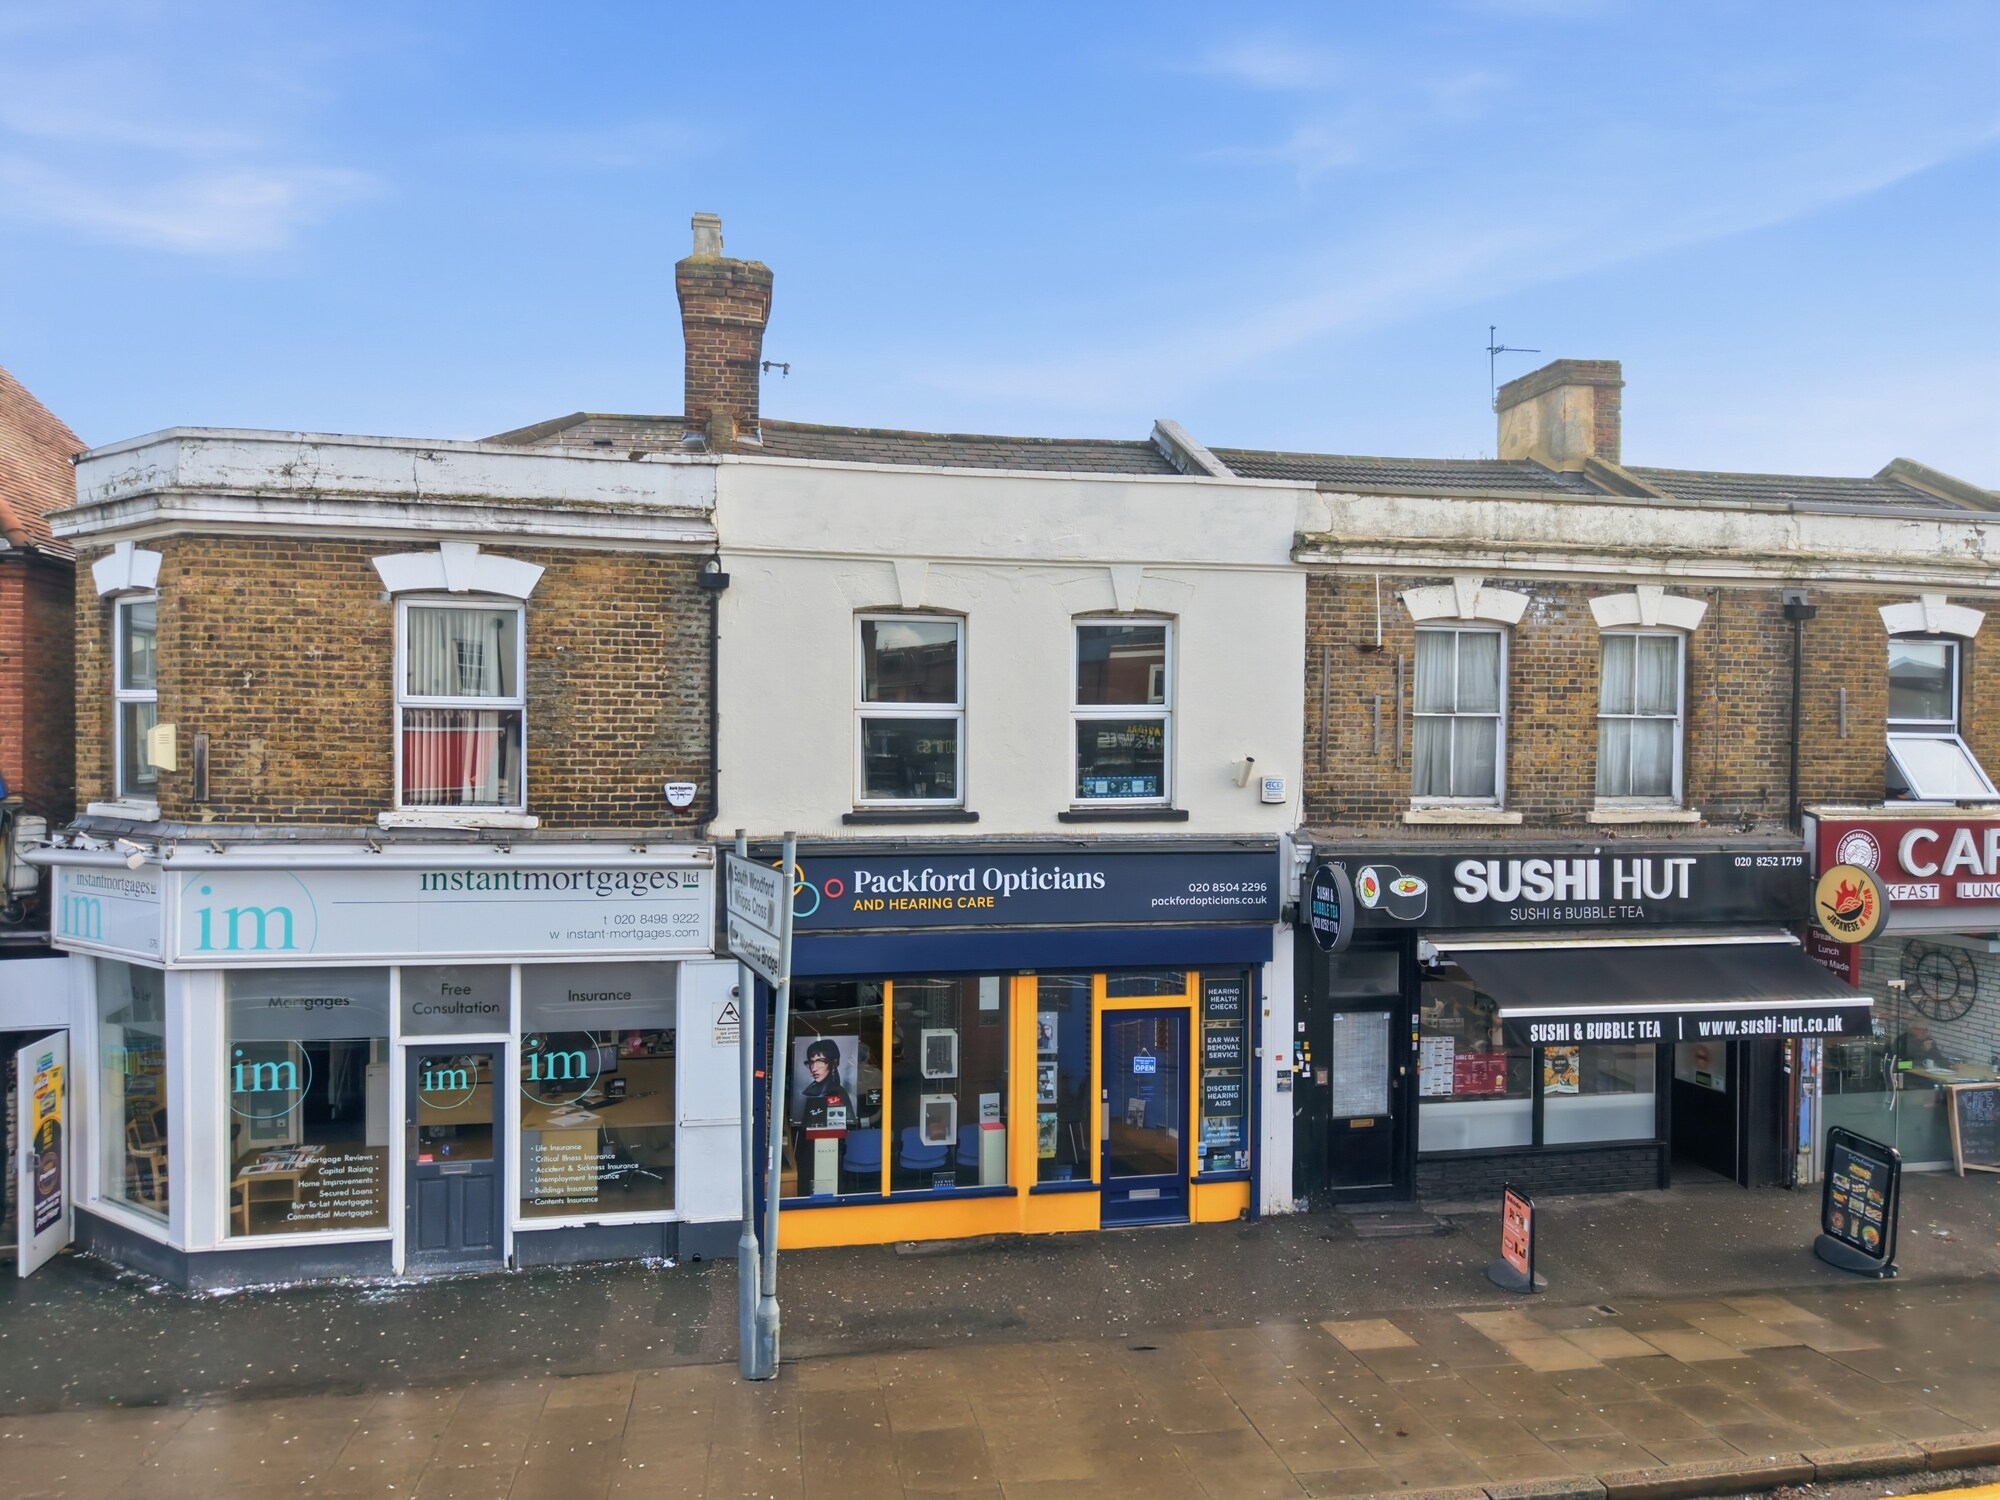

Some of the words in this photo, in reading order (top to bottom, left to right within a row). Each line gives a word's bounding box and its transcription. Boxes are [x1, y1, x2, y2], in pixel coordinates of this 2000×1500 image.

[1735, 856, 1752, 867] 020
[1756, 856, 1778, 867] 8252
[1780, 856, 1803, 867] 1719
[76, 872, 150, 897] instantmortgages
[420, 870, 679, 896] instantmortgages
[683, 871, 699, 884] ltd
[734, 866, 748, 887] South
[749, 873, 775, 898] Woodford
[853, 868, 976, 893] Packford
[982, 867, 1106, 897] Opticians
[1189, 883, 1210, 892] 020
[1212, 883, 1240, 892] 8504
[1242, 883, 1267, 892] 2296
[1454, 858, 1600, 903] SUSHI
[1613, 858, 1697, 899] HUT
[1887, 885, 1938, 899] KFAST
[61, 874, 103, 941] im
[853, 899, 885, 911] AND
[889, 897, 953, 910] HEARING
[957, 896, 995, 909] CARE
[1151, 895, 1267, 907] packfordopticians.co.uk
[752, 897, 767, 920] Cross
[1510, 907, 1550, 920] SUSHI
[1553, 907, 1561, 919] &
[1565, 906, 1616, 919] BUBBLE
[1619, 906, 1644, 918] TEA
[194, 885, 300, 950] im
[603, 915, 607, 925] t
[614, 914, 636, 925] 020
[640, 913, 668, 924] 8498
[673, 913, 700, 924] 9222
[1827, 914, 1860, 932] JAPANESE
[550, 930, 560, 939] w
[567, 928, 700, 940] instant-mortgages.com
[1818, 944, 1839, 956] Lunch
[762, 948, 778, 975] Bridge
[1829, 960, 1849, 972] Made
[441, 983, 471, 996] Free
[568, 989, 631, 1002] Insurance
[268, 996, 350, 1010] Mortgages
[412, 1001, 500, 1015] Consultation
[1530, 1023, 1570, 1042] SUSHI
[1574, 1022, 1583, 1041] &
[1587, 1020, 1635, 1040] BUBBLE
[1638, 1020, 1661, 1039] TEA
[1699, 1015, 1843, 1037] www.sushi-hut.co.uk
[527, 1039, 591, 1081] im
[232, 1049, 301, 1092] im
[423, 1061, 469, 1091] im
[305, 1155, 341, 1165] Mortgage
[344, 1154, 373, 1162] Reviews
[319, 1166, 345, 1176] Capital
[347, 1165, 373, 1174] Raising
[535, 1165, 565, 1173] Accident
[298, 1180, 320, 1188] Home
[323, 1177, 373, 1187] Improvements
[534, 1174, 586, 1183] Unemployment
[319, 1188, 349, 1197] Secured
[352, 1187, 373, 1195] Loans
[534, 1186, 564, 1194] Buildings
[291, 1200, 330, 1210] Buy-To-Let
[333, 1199, 373, 1208] Mortgages
[333, 1210, 373, 1218] Mortgages
